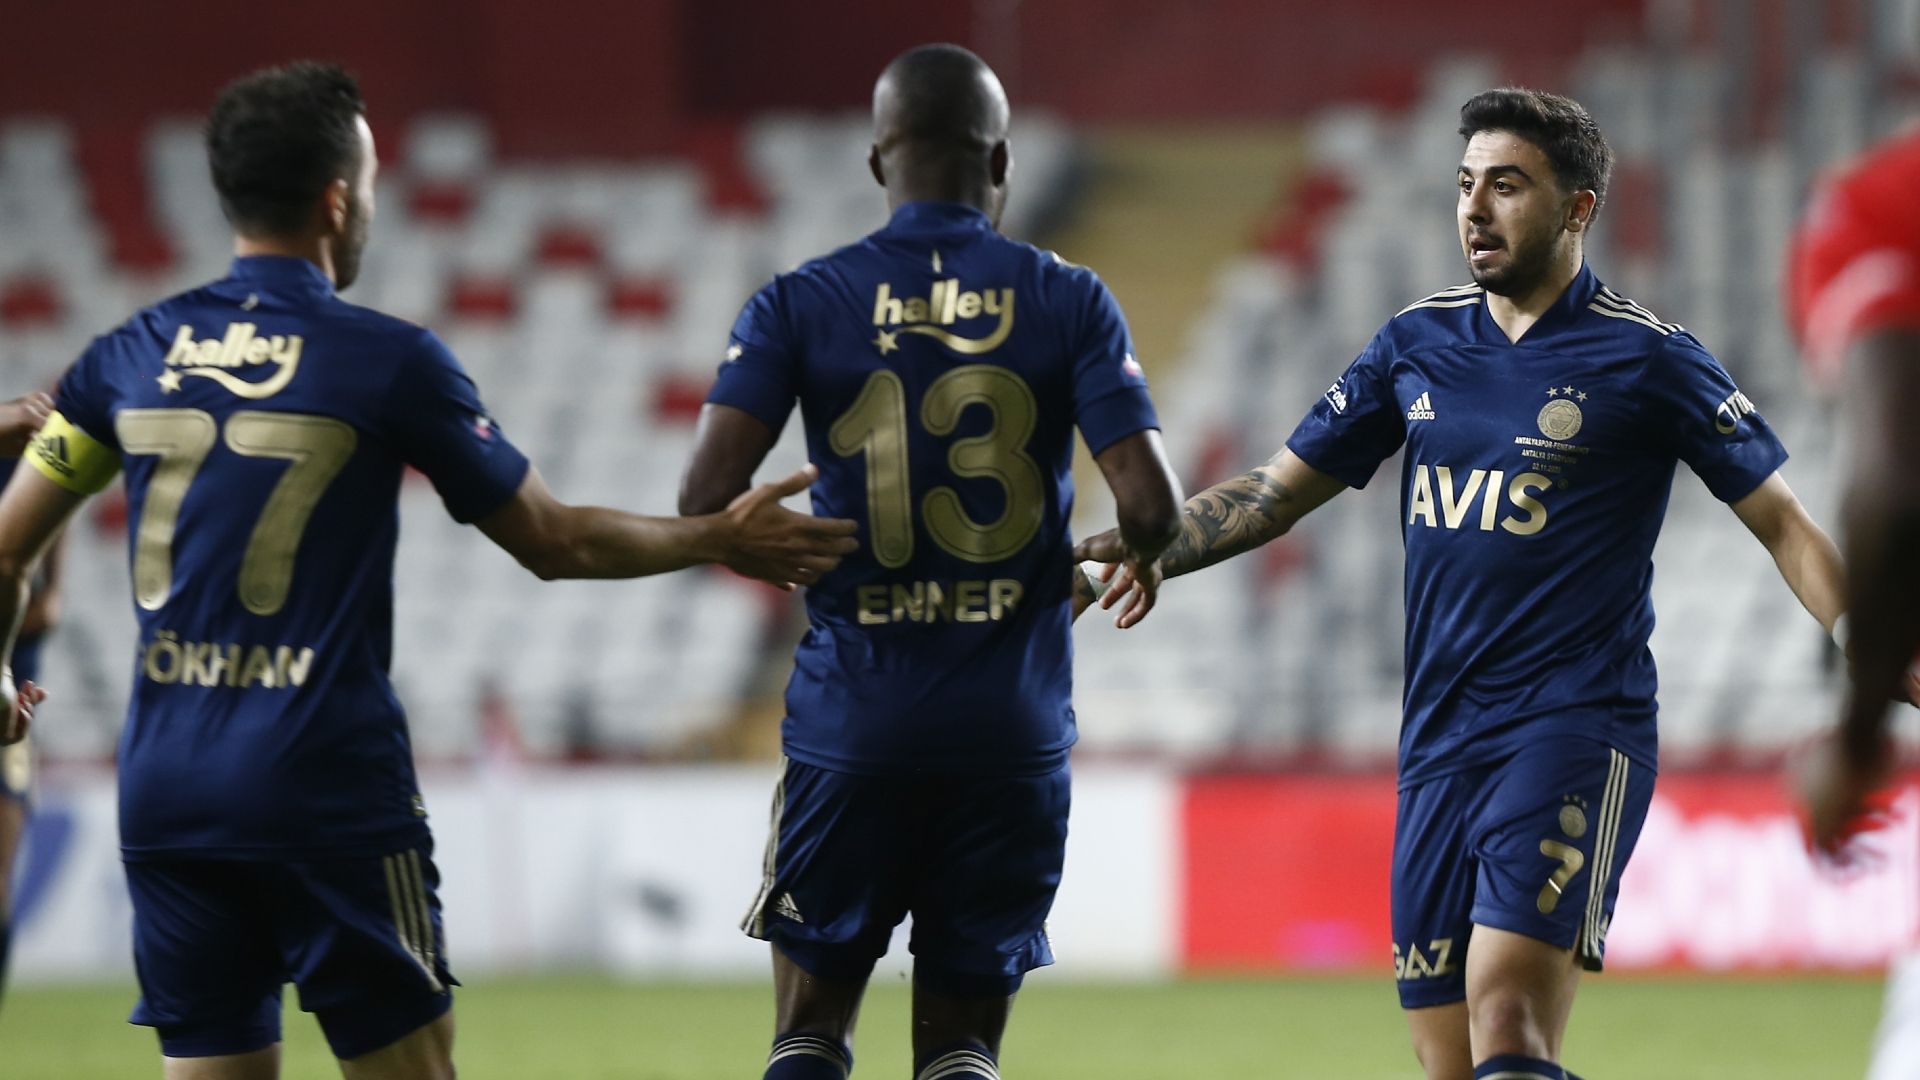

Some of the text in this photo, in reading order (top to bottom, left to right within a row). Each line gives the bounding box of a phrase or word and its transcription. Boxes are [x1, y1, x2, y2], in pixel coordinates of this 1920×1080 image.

[873, 278, 1015, 354] halley
[164, 321, 303, 399] halley
[1407, 409, 1436, 421] adidas
[829, 364, 1045, 568] 13
[1521, 448, 1546, 460] ANTALYA
[114, 408, 358, 616] 77
[1408, 464, 1553, 536] AVIS
[857, 578, 1025, 626] ENNER
[140, 628, 315, 688] ÖKHAN
[1536, 838, 1585, 914] 7
